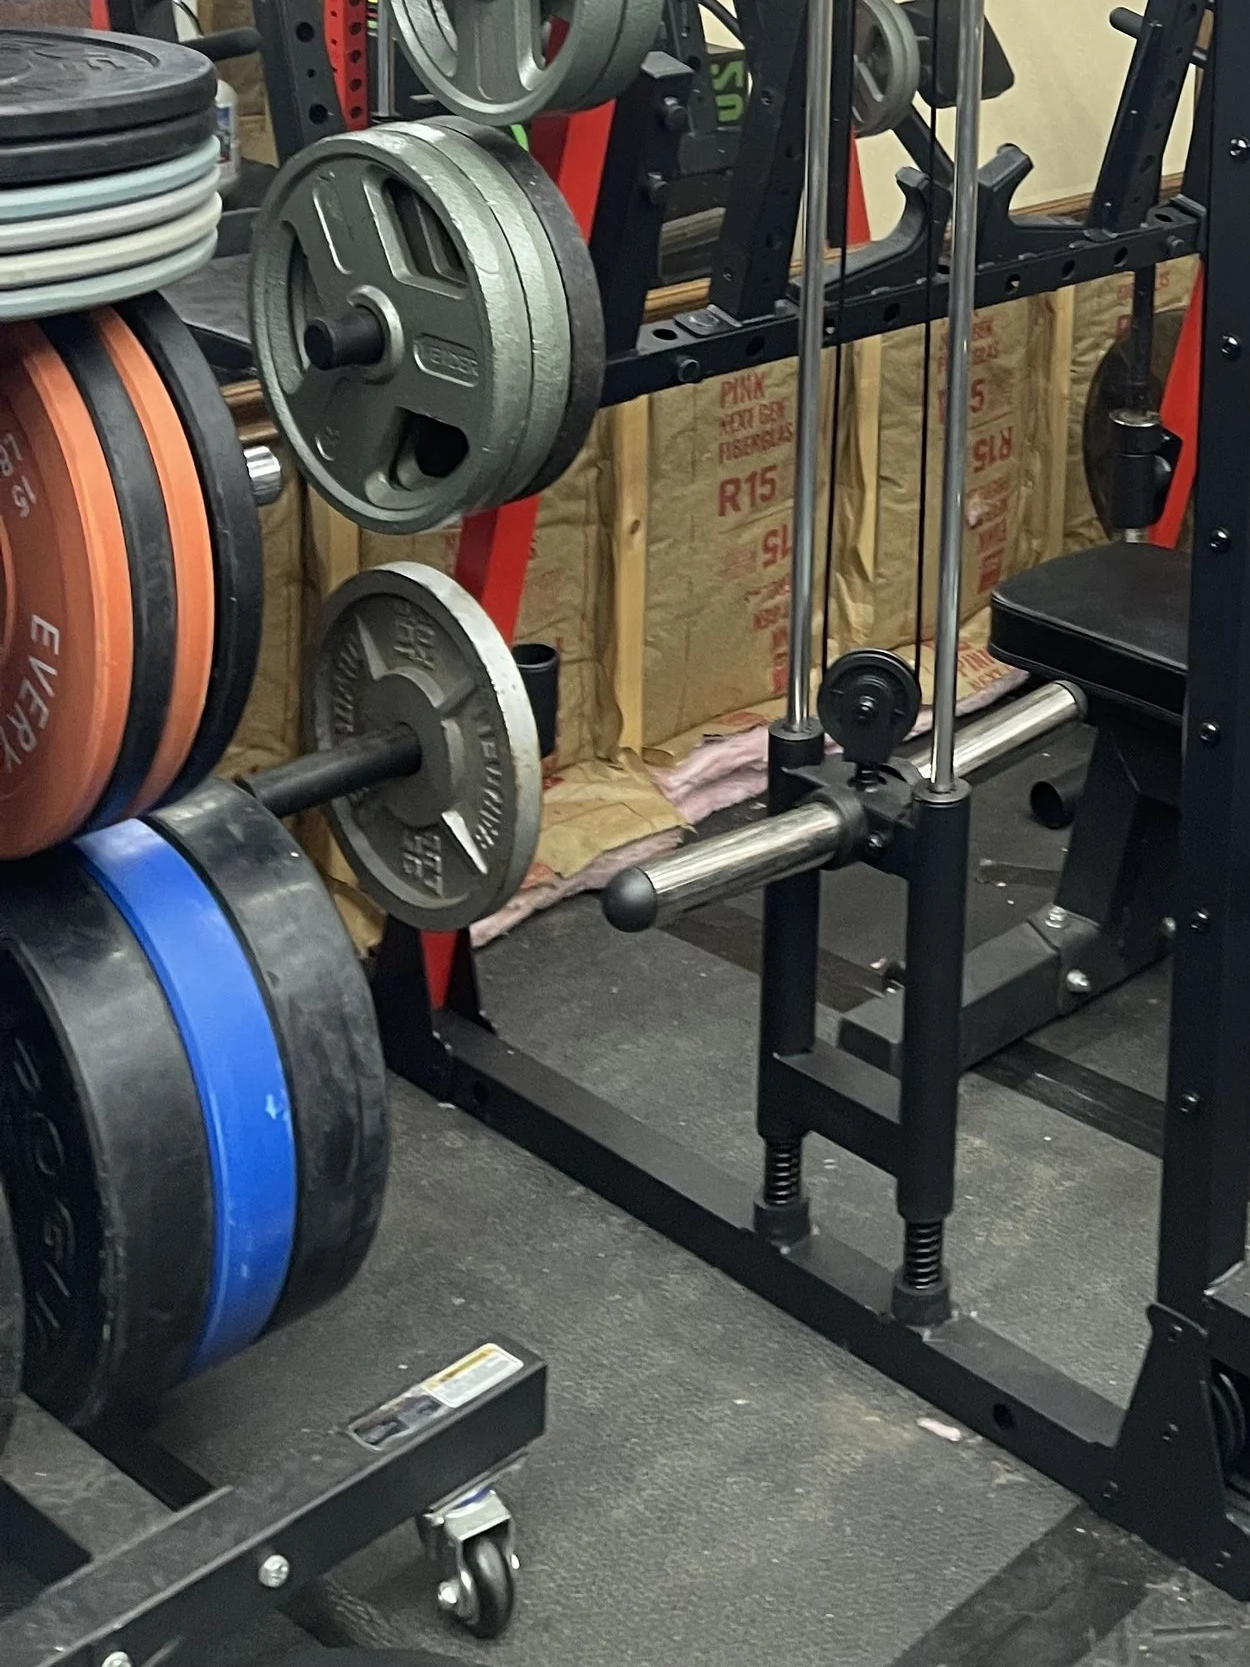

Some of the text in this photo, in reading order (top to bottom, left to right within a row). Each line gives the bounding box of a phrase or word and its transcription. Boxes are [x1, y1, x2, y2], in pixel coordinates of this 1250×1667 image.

[720, 371, 767, 408] PINK
[972, 426, 1013, 473] R15
[718, 464, 778, 517] R15
[762, 523, 792, 569] 15
